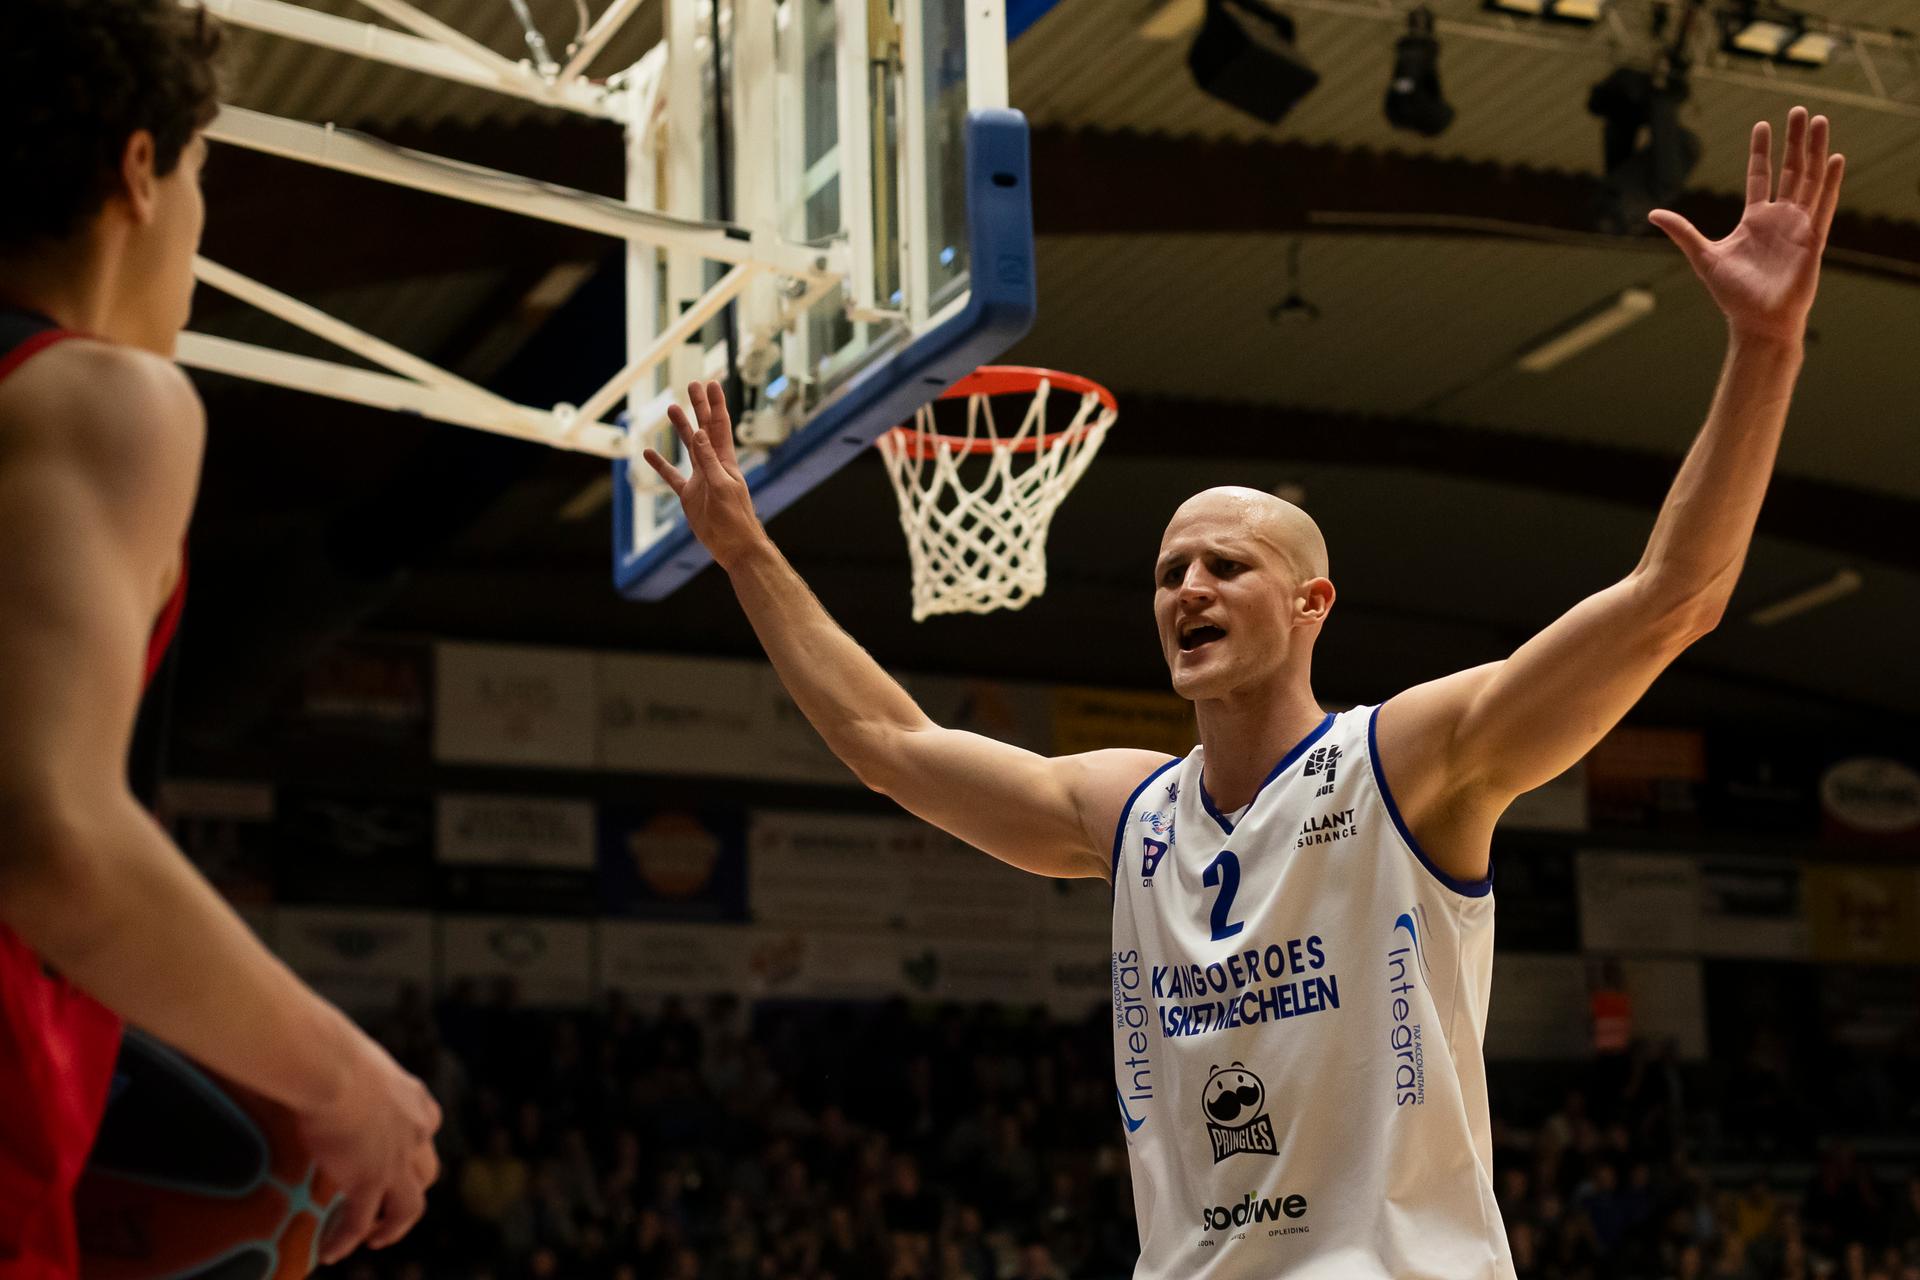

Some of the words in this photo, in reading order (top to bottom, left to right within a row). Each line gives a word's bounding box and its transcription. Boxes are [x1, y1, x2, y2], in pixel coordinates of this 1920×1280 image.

[1295, 825, 1358, 849] SURANCE
[1300, 808, 1355, 835] LLANT
[1203, 850, 1245, 942] 2
[1152, 935, 1326, 999] KANGOEROES
[1118, 950, 1153, 1101] Integras
[1213, 974, 1341, 1031] MECHELEN
[1388, 948, 1417, 1106] Integras
[1413, 1024, 1421, 1040] TAX
[1415, 1041, 1425, 1105] ACCOUNTANTS
[1211, 1121, 1273, 1159] PRINGLES
[1203, 1190, 1308, 1232] sodiwe
[1268, 1225, 1310, 1237] OPLEIDING
